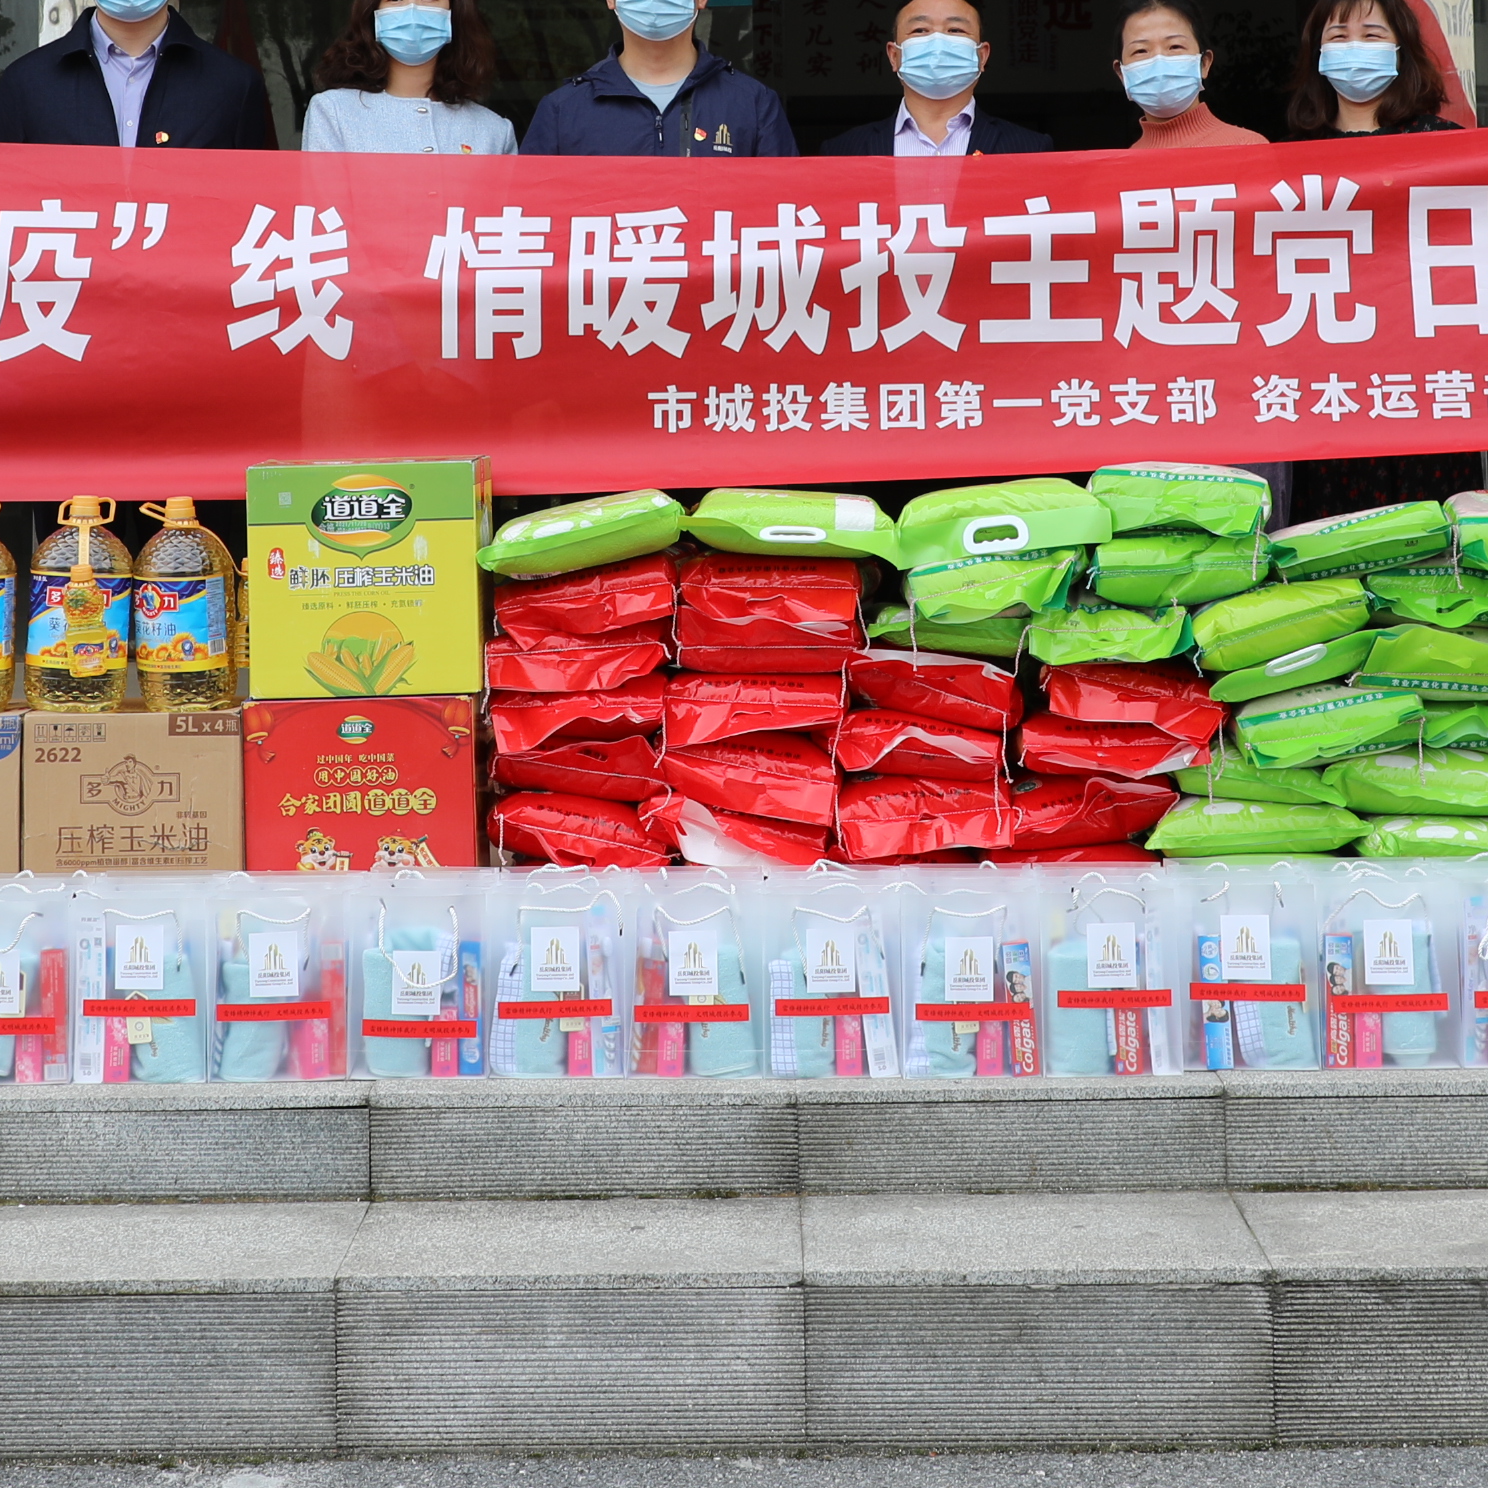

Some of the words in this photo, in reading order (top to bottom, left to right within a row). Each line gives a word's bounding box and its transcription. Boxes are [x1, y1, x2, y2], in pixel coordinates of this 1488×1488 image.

[648, 378, 1217, 433] 市城投集团第一党支部
[324, 493, 406, 520] 道道全
[341, 722, 376, 736] 道道全
[34, 747, 82, 763] 2622
[317, 754, 353, 764] 过中国年
[358, 753, 395, 763] 吃中国菜
[317, 768, 397, 783] 用中国好油
[112, 797, 147, 814] MIGHTY
[55, 823, 209, 856] 压榨玉米油
[1022, 1019, 1034, 1073] Colgat
[1126, 1011, 1139, 1072] Colgate
